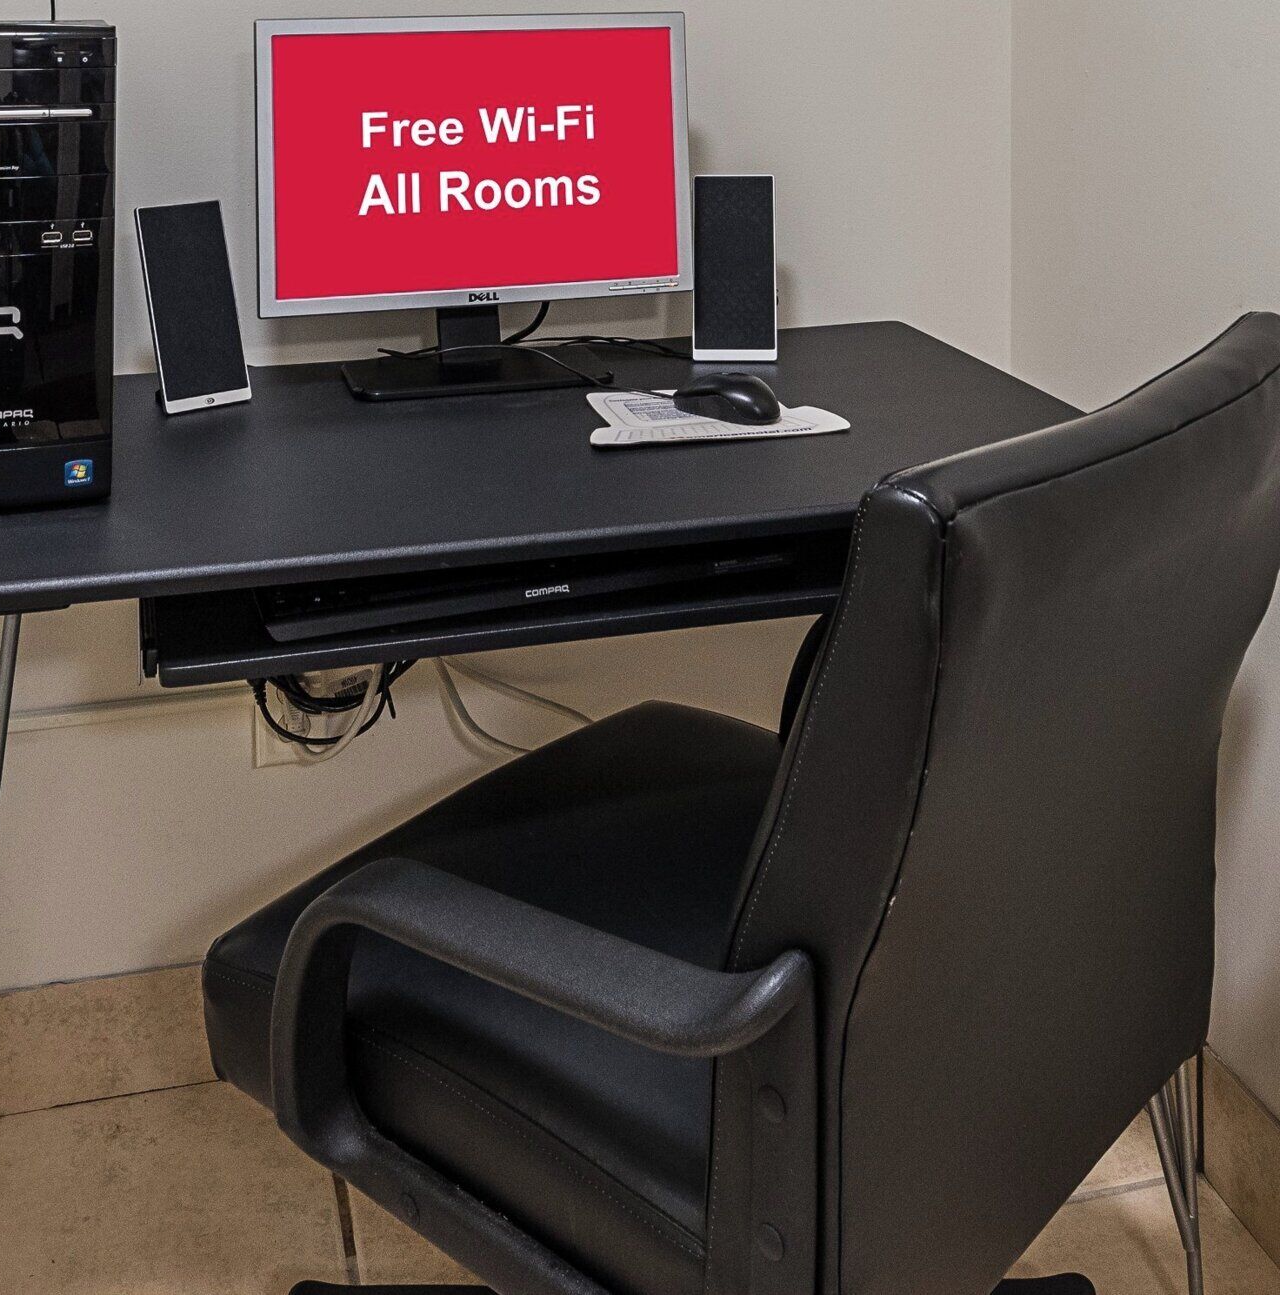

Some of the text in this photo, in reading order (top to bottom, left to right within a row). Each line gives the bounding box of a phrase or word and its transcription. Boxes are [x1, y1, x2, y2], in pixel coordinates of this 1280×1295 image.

[361, 104, 596, 148] Free Wi-Fi
[358, 170, 601, 216] All Rooms
[469, 292, 499, 302] DELL
[525, 584, 570, 598] COMPAQ
